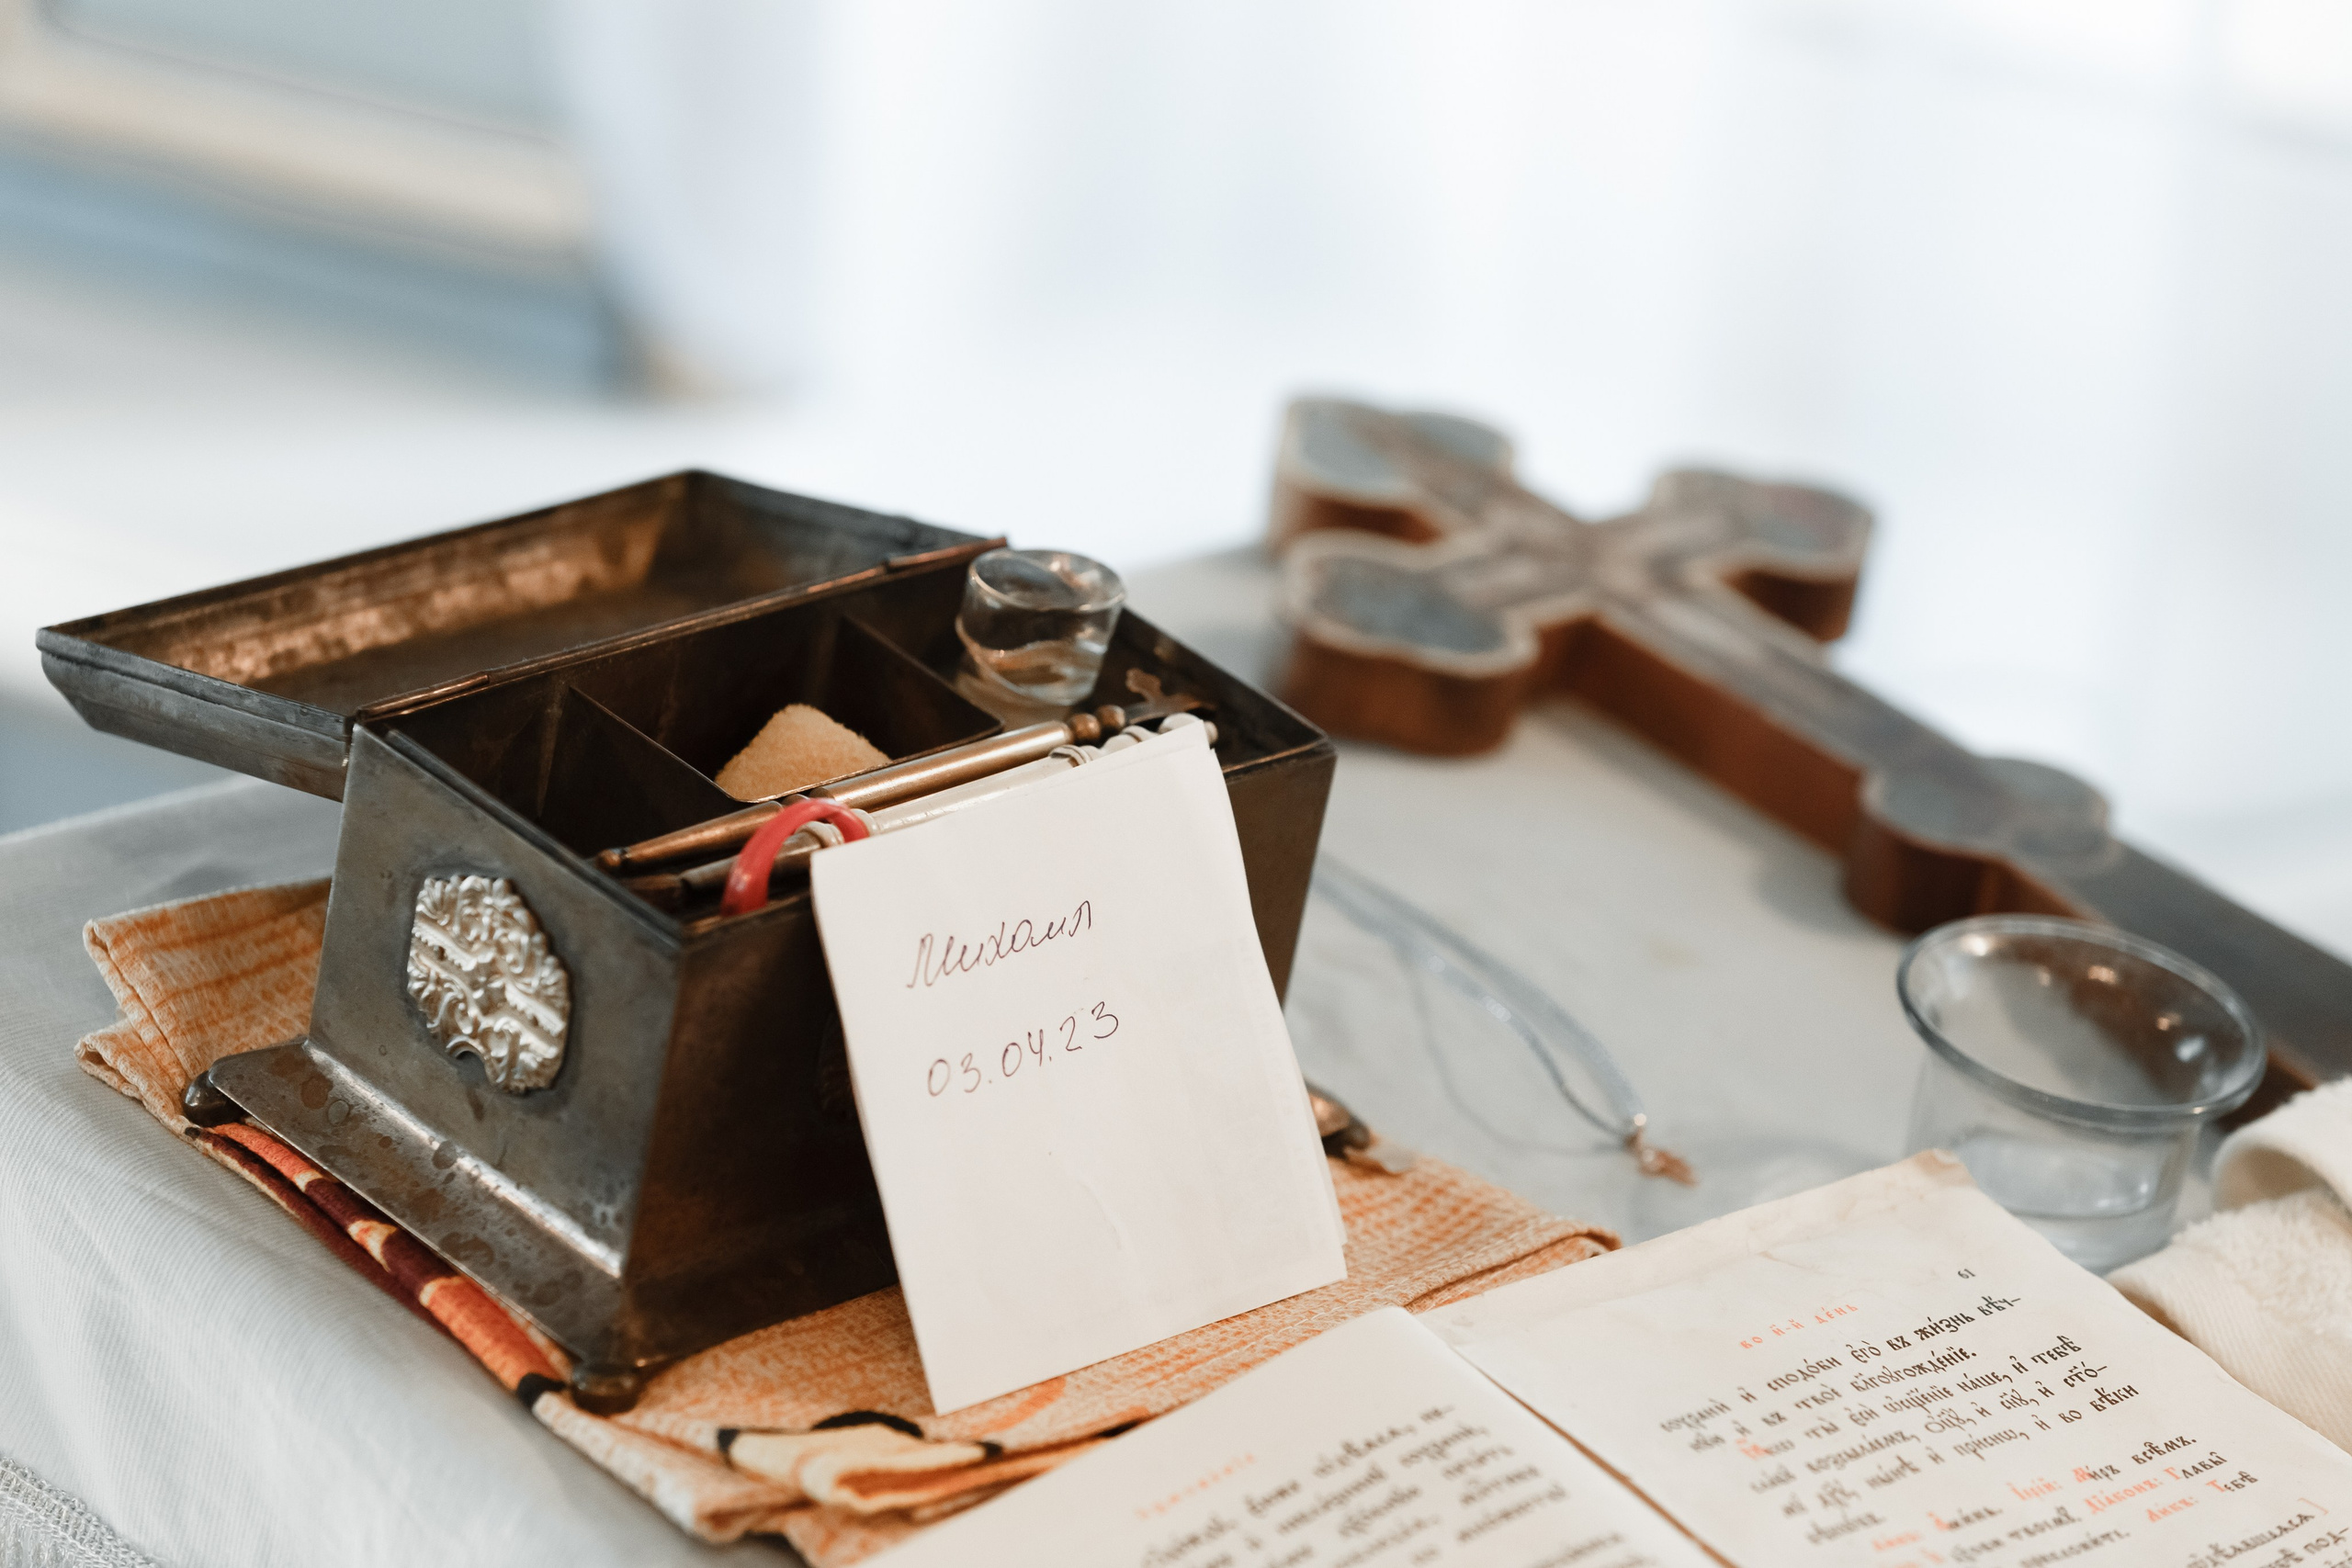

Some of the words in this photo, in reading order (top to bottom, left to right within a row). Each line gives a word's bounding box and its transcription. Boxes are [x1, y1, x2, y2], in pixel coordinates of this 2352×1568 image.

[906, 900, 1091, 988] Михаил
[927, 1001, 1118, 1097] 03.04.23
[1957, 1269, 1976, 1280] 61
